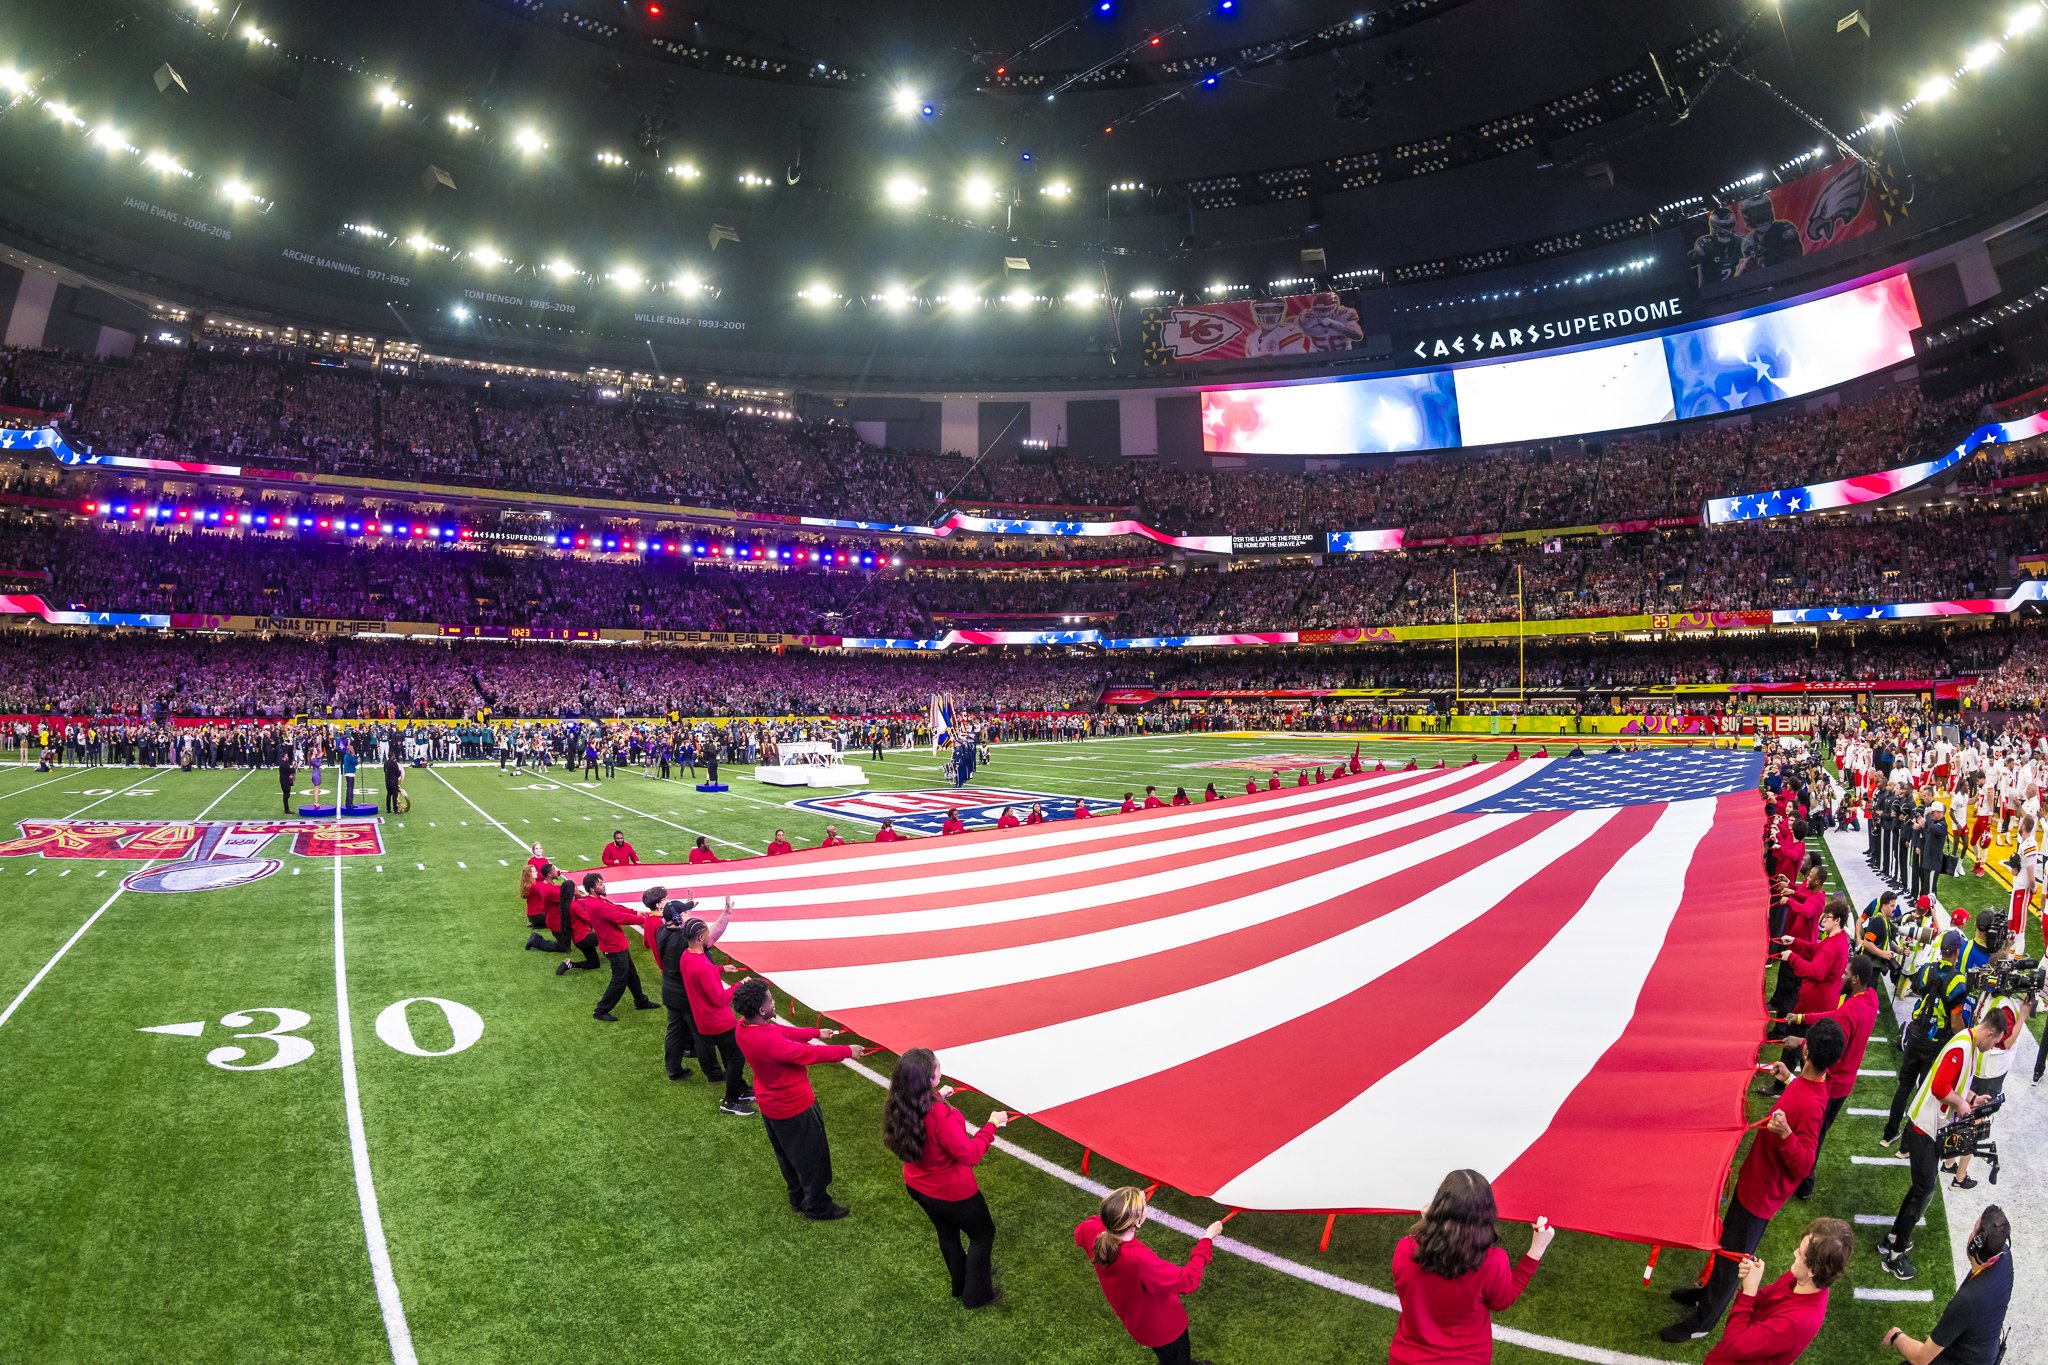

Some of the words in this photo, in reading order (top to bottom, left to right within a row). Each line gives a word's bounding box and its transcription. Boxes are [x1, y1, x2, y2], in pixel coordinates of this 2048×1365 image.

[123, 196, 149, 212] JAHRI
[150, 205, 179, 223] EVANS
[183, 216, 232, 240] 2006-2016
[281, 248, 316, 265] ARCHIE
[315, 257, 361, 276] MANNING
[366, 269, 410, 287] 1971-1982
[464, 289, 484, 300] TOM
[486, 293, 523, 306] BENSON
[529, 299, 576, 314] 1985-2018
[634, 313, 665, 324] WILLIE
[666, 316, 692, 326] ROAF
[697, 319, 745, 330] 1993-2001
[1543, 297, 1682, 340] SUPERDOME
[254, 617, 300, 630] KANSAS
[305, 620, 331, 632] CITY
[335, 621, 387, 632] CHIEFS
[1653, 615, 1668, 628] 25
[511, 628, 530, 637] 10:23
[643, 631, 730, 643] PHILADELPHIA
[734, 633, 783, 644] EAGLES
[816, 790, 1039, 815] NFL
